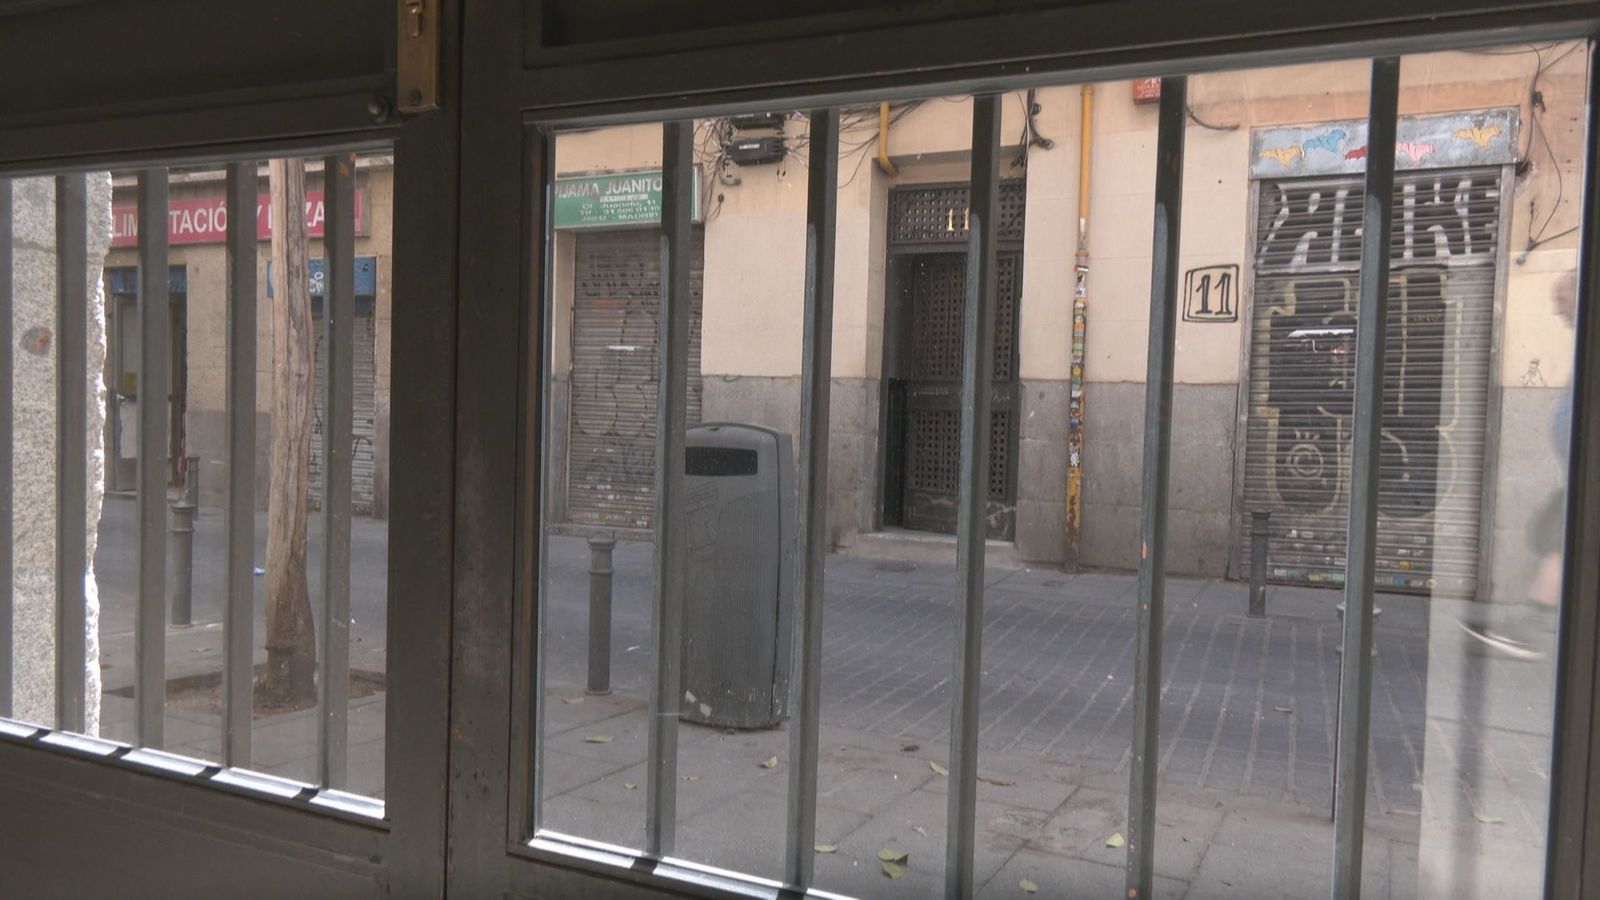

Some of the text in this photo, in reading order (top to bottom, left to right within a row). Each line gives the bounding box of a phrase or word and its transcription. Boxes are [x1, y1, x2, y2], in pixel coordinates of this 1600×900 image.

[605, 177, 662, 195] JUANITO
[947, 207, 970, 231] 11
[1195, 272, 1232, 315] 11
